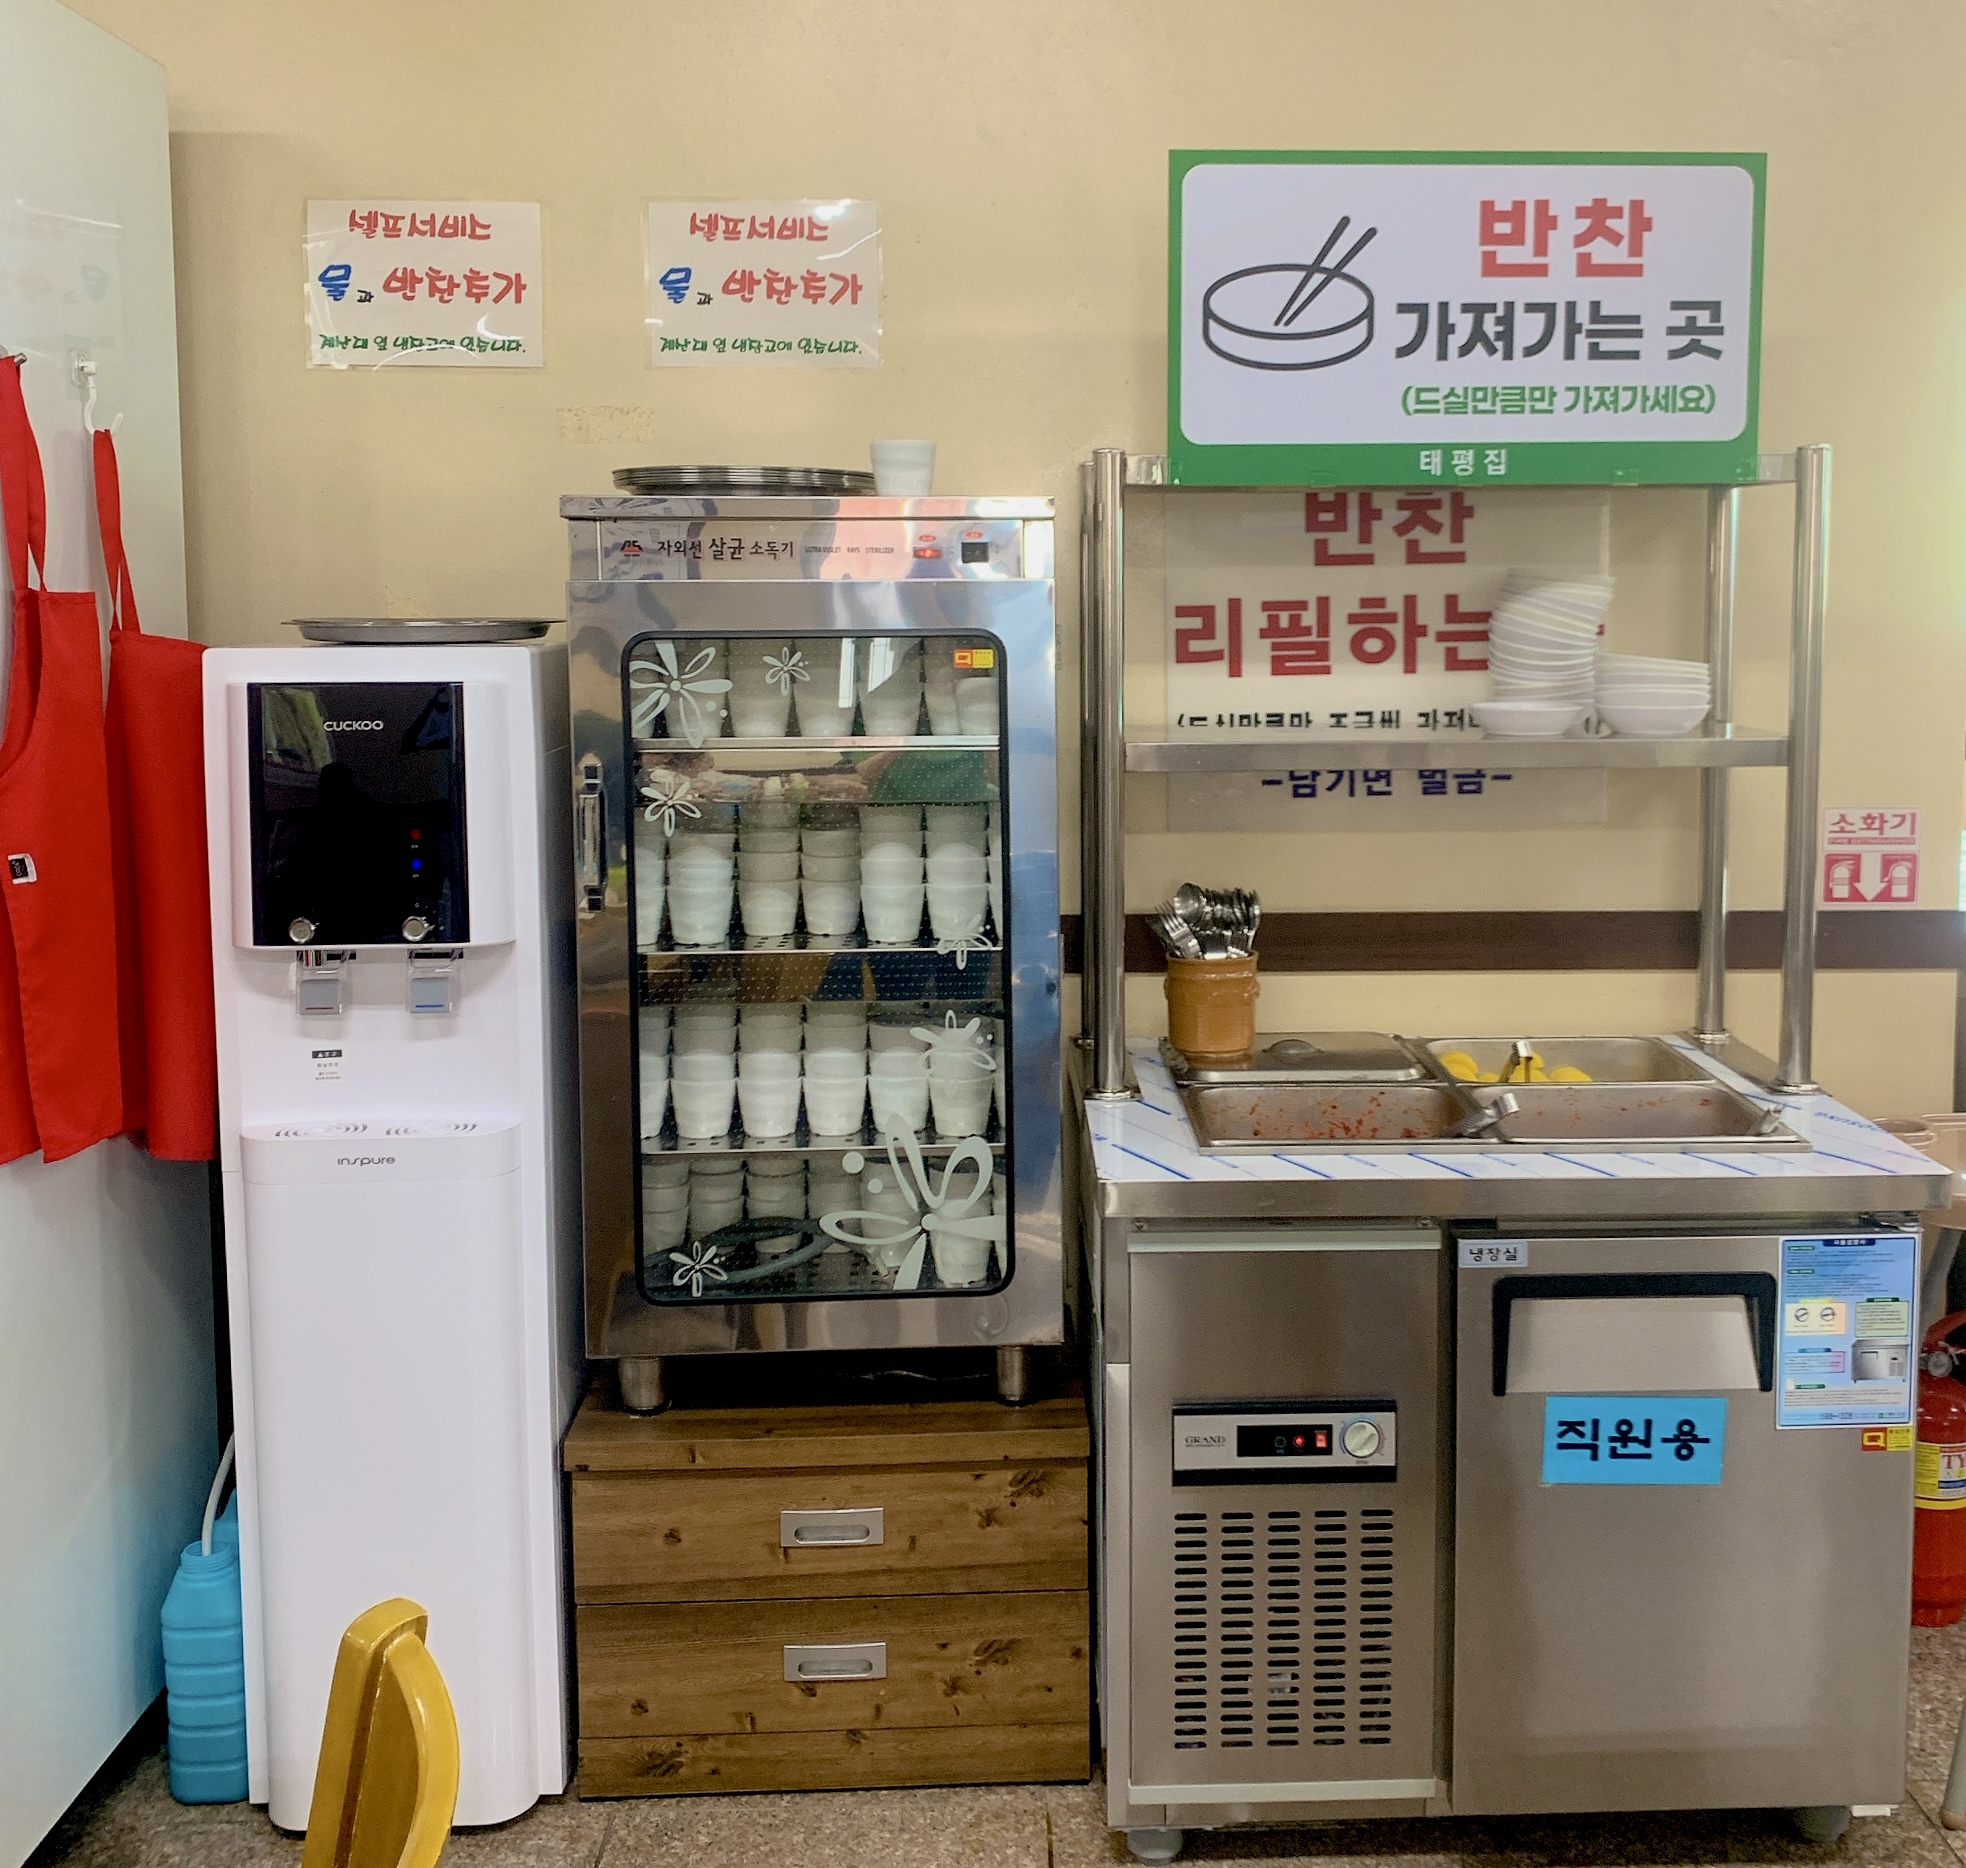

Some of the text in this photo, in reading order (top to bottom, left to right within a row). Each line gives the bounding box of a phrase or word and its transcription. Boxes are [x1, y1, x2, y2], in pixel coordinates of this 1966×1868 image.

[1479, 197, 1653, 278] 반찬
[1395, 300, 1725, 362] 가져가는 곳
[1401, 384, 1716, 416] (드실만큼만 가져가세요)
[1419, 448, 1508, 477] 태평집
[1305, 491, 1475, 567] 반찬
[1174, 594, 1493, 678] 리필하는
[323, 720, 384, 732] CUCKOO
[1828, 812, 1916, 835] 소화기
[337, 1156, 396, 1167] inspure
[1469, 1247, 1518, 1262] 냉장실
[1184, 1435, 1227, 1444] GRAND
[1556, 1418, 1711, 1462] 직원용
